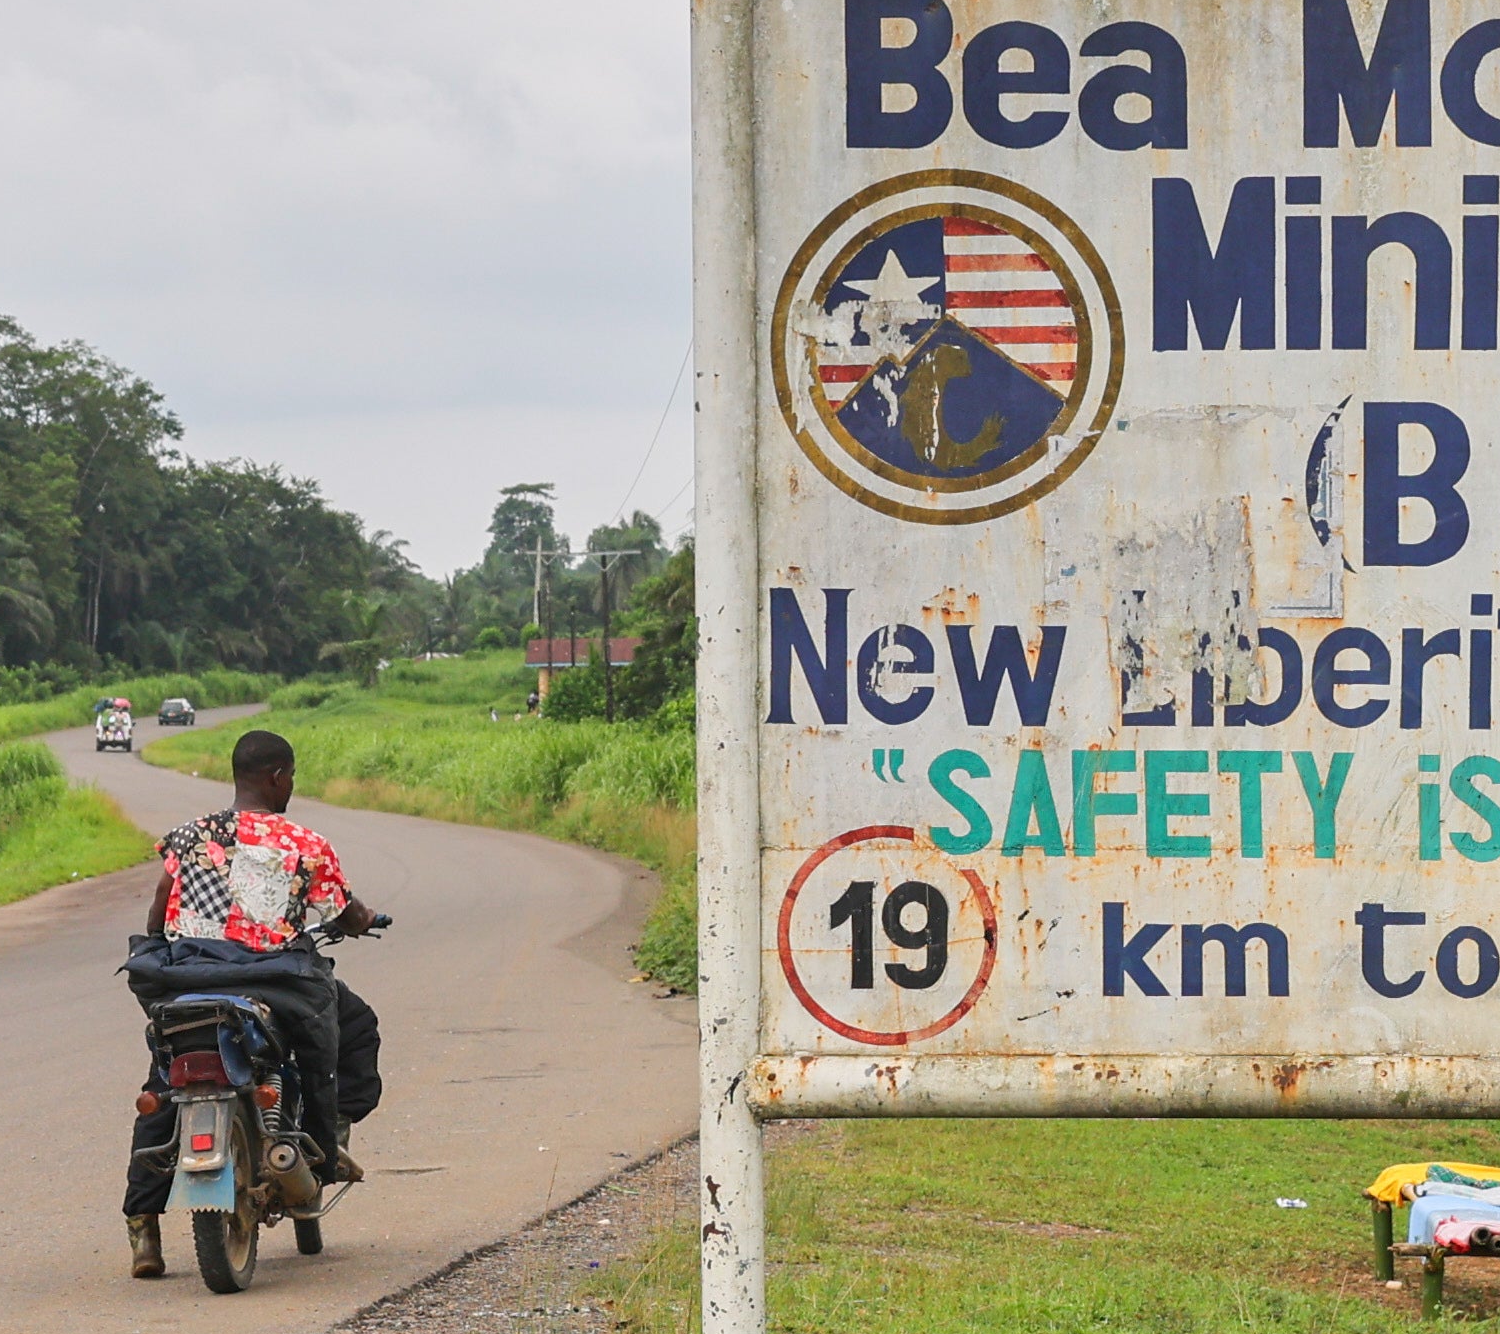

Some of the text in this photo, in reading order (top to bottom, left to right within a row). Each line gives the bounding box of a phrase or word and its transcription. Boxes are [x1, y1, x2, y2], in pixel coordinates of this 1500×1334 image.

[764, 587, 1066, 726] New
[828, 880, 950, 991] 19
[1102, 901, 1290, 998] km
[1356, 903, 1500, 998] to
